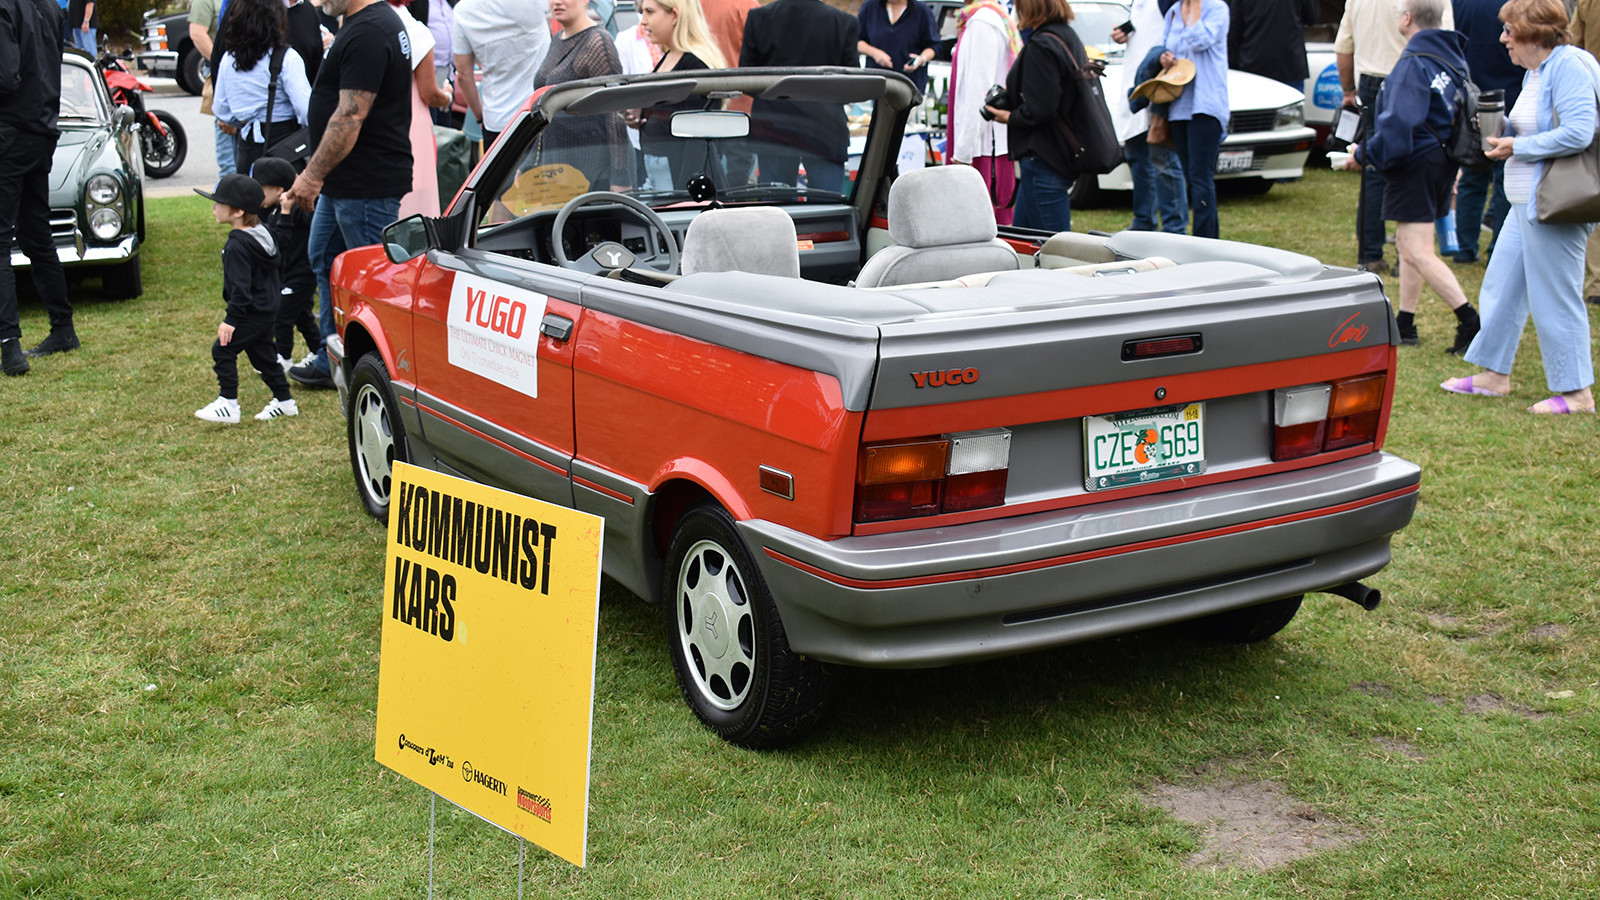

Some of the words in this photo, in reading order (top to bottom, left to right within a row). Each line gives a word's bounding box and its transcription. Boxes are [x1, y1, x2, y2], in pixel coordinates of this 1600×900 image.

[465, 286, 527, 339] YUGO
[910, 367, 979, 388] YUGO
[1094, 431, 1134, 470] CZE
[1160, 421, 1200, 460] S69
[397, 480, 557, 596] KOMMUNIST
[392, 556, 457, 642] KARS
[474, 769, 509, 797] HAGERTY
